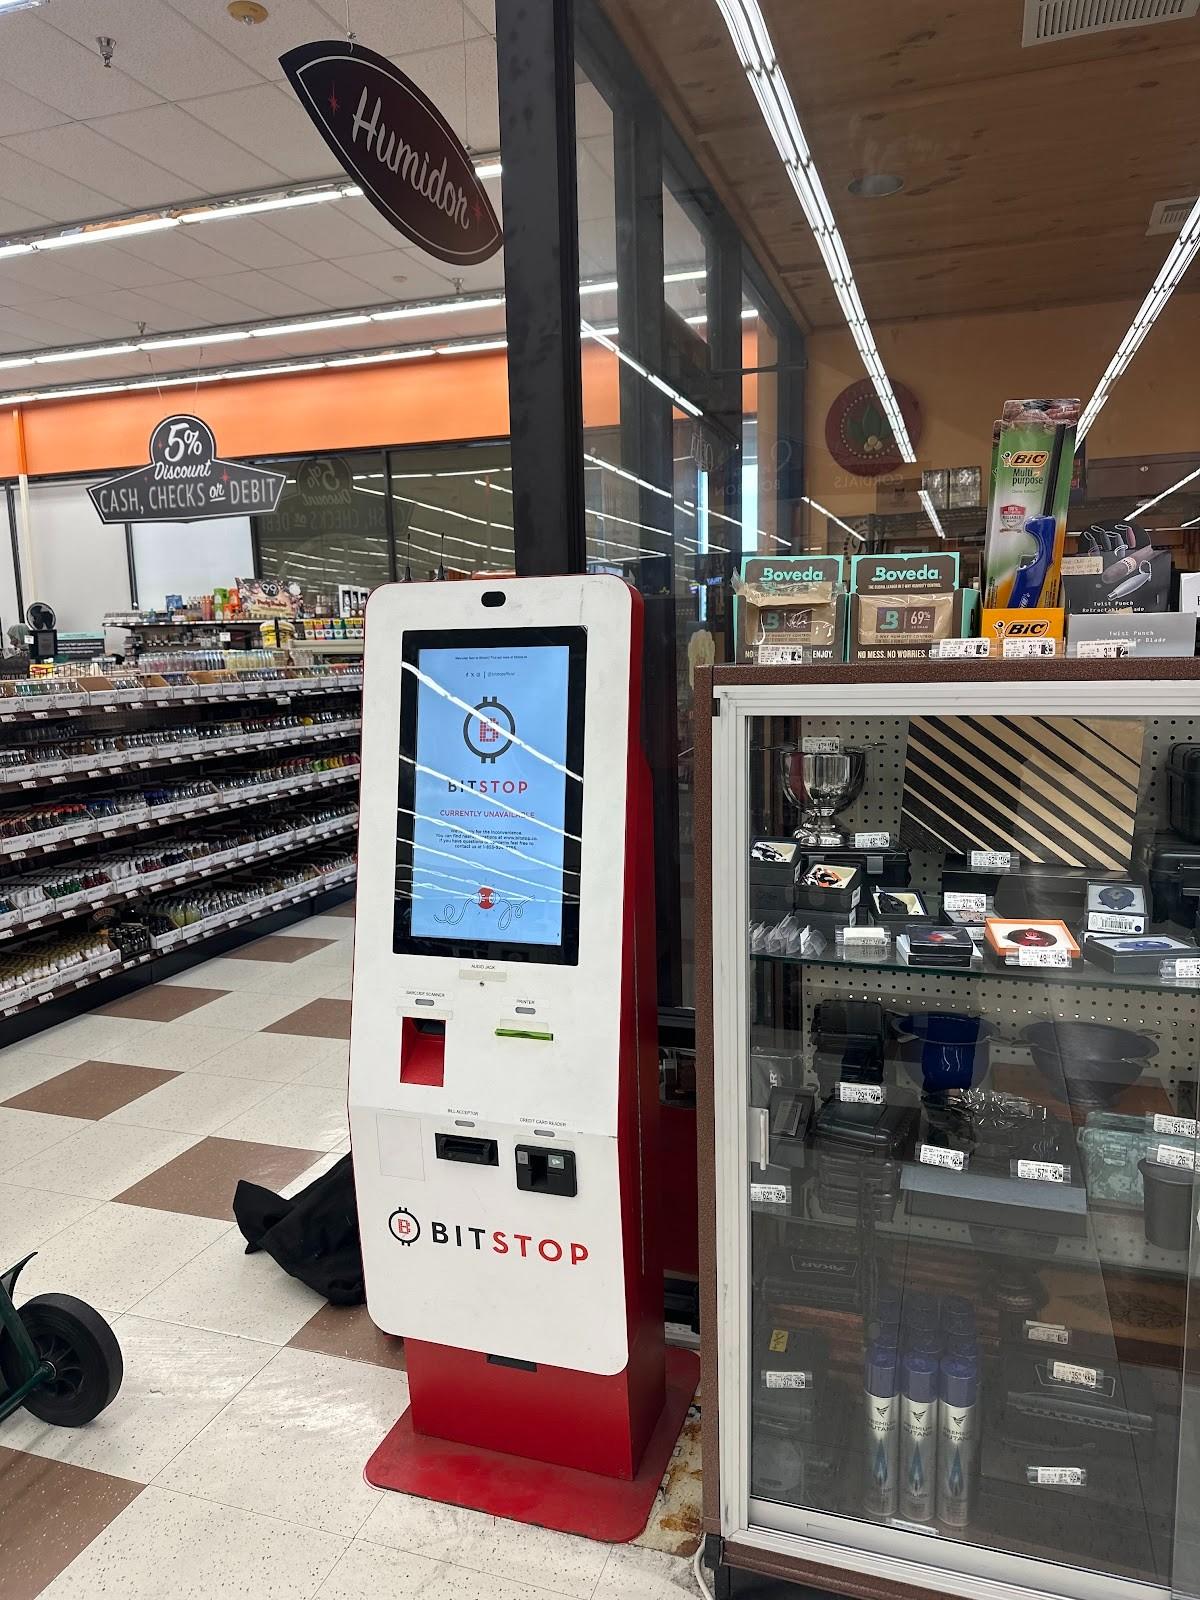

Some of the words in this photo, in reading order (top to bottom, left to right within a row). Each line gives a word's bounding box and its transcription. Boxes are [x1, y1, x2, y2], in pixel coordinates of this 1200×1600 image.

[352, 86, 469, 229] Humidor
[164, 423, 203, 462] 5%
[154, 459, 212, 480] Discount
[1013, 468, 1033, 477] Multi
[1012, 477, 1043, 487] purpose
[100, 488, 144, 515] CASH,
[149, 483, 205, 509] CHECKS
[231, 478, 276, 504] DEBIT
[759, 566, 823, 581] Boveda
[871, 564, 939, 581] Boveda
[262, 584, 277, 594] 99
[910, 610, 931, 625] 69%
[857, 651, 866, 659] NO
[867, 650, 886, 659] MESS.
[887, 650, 896, 658] NO
[897, 650, 927, 658] WORRIES.
[448, 780, 528, 793] BITSTOP
[439, 809, 482, 817] CURRENTLY
[431, 1222, 589, 1265] BITSTOP
